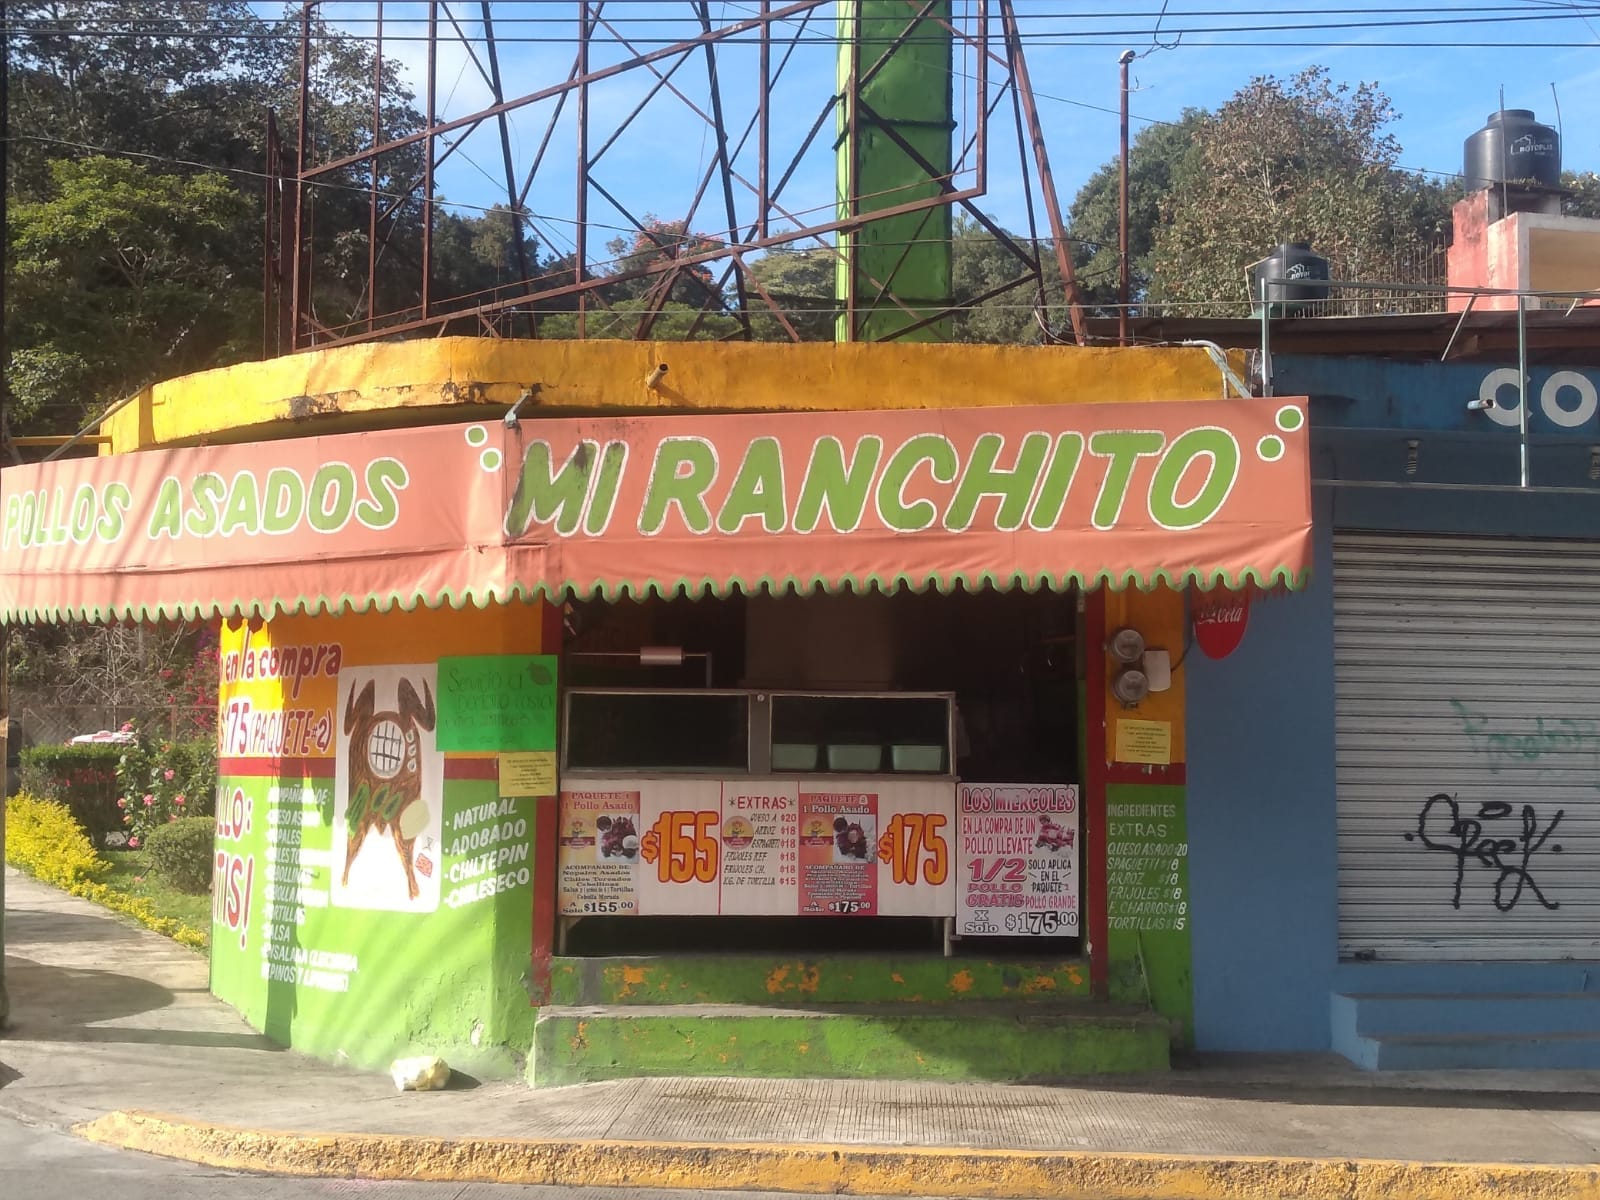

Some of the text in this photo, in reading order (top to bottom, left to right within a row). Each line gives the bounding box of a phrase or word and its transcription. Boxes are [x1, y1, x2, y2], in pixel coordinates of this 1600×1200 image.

[1479, 367, 1598, 428] CO
[504, 425, 1242, 537] MI RANCHITO
[2, 456, 410, 549] POLLOS ASADOS
[226, 625, 342, 701] en la compra
[571, 792, 622, 800] PAQUETE
[809, 795, 857, 803] PAQUETE
[962, 787, 1076, 814] LOS MIERCOLES
[574, 801, 599, 809] Pollo
[602, 801, 634, 809] Asado
[811, 804, 837, 813] Pollo
[839, 805, 870, 813] Asado
[1107, 804, 1176, 817] INGREDIENTES
[453, 798, 517, 830] NATURAL
[780, 813, 797, 823] $20
[780, 826, 796, 835] $18
[963, 817, 1036, 834] EN LA COMPRA DE UN
[265, 828, 301, 845] PALES
[451, 818, 527, 857] ADOBADO
[780, 838, 796, 848] $18
[640, 810, 720, 884] $155
[877, 813, 949, 886] $175
[965, 837, 1033, 854] POLLO LLEVATE
[1107, 842, 1141, 857] QUESO
[1141, 842, 1174, 856] ASADO
[449, 842, 529, 883] CHILTEPIN
[779, 852, 796, 861] $18
[779, 864, 796, 874] $18
[967, 858, 1027, 882] 1/2
[1028, 859, 1072, 869] SOLO APLICA
[779, 877, 797, 886] $15
[1040, 871, 1059, 881] EN EL
[1107, 872, 1145, 885] ARROZ
[967, 883, 1023, 893] POLLO
[1032, 882, 1062, 893] PAQUETE
[1108, 886, 1161, 900] FRIJOLES
[583, 901, 634, 913] $155.00
[966, 894, 1025, 907] GRATIS
[1026, 895, 1076, 909] POLLO GRANDE
[1119, 901, 1169, 914] CHARROS
[974, 910, 989, 921] X
[964, 922, 999, 934] Solo
[1005, 911, 1078, 934] $175.00
[1107, 916, 1166, 930] TORTILLAS
[260, 962, 297, 983] PINOS
